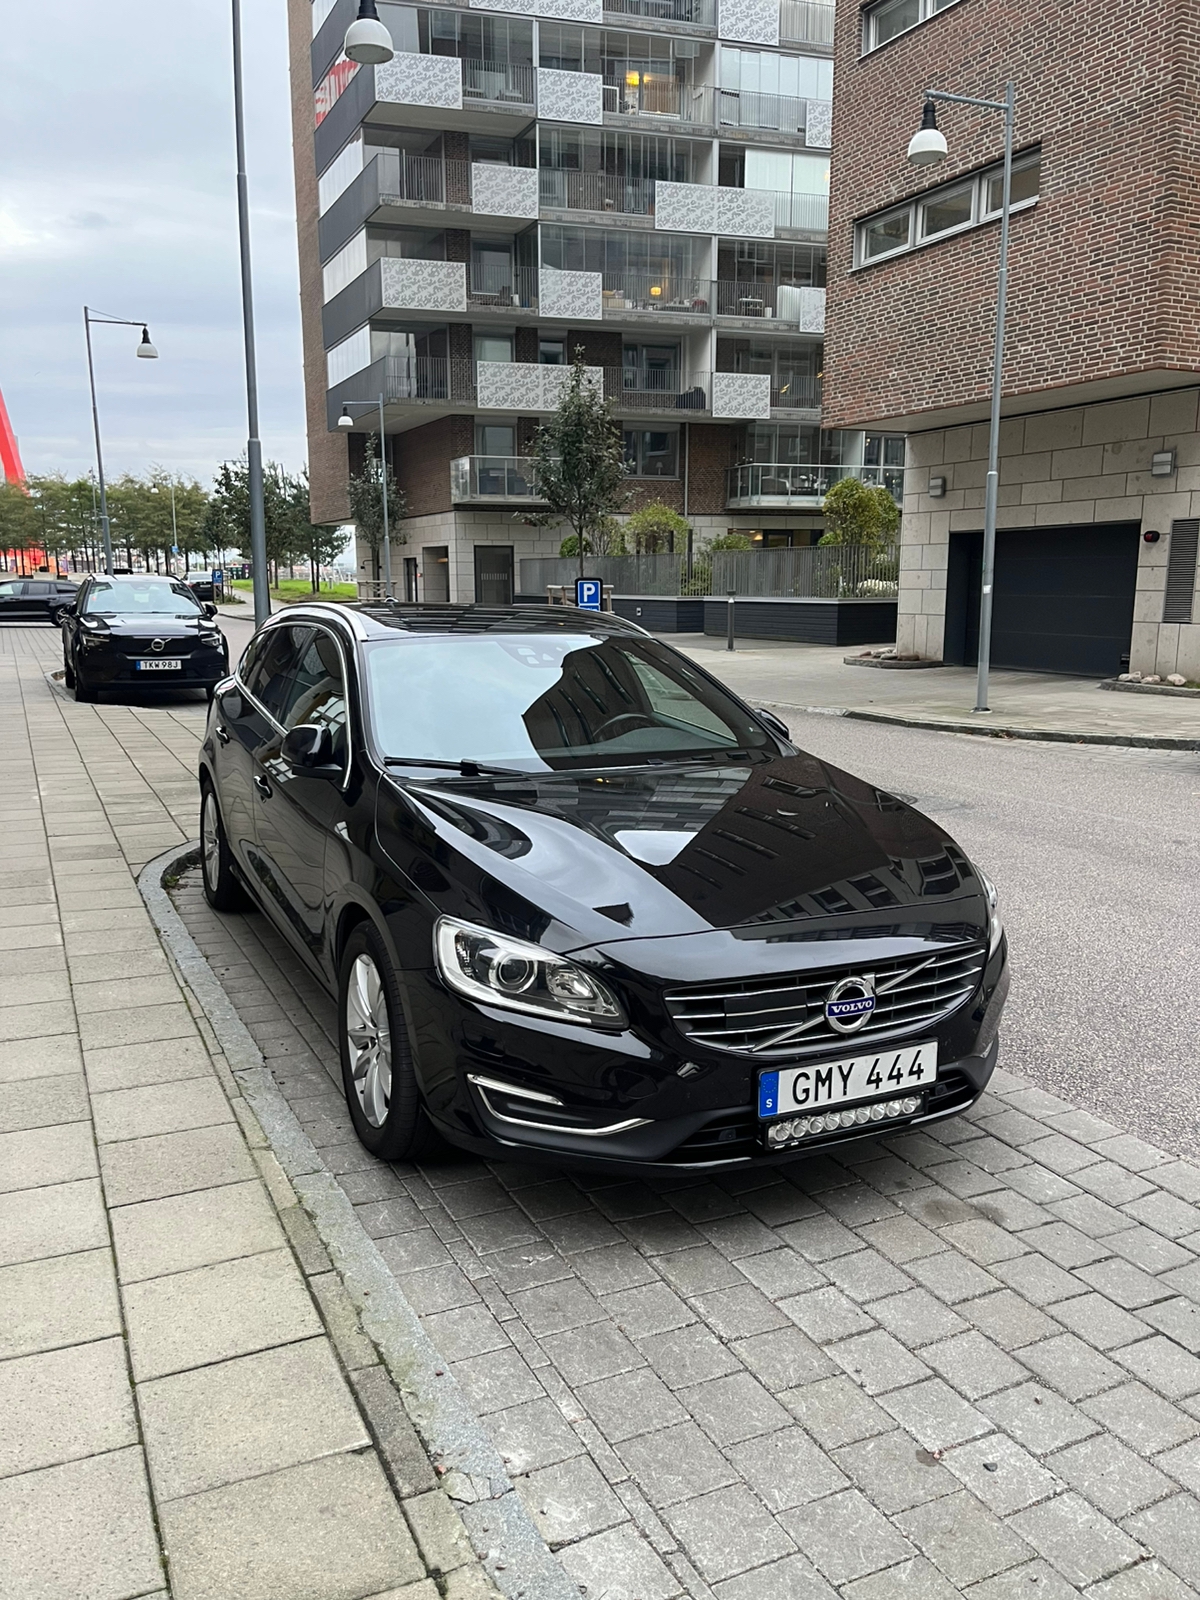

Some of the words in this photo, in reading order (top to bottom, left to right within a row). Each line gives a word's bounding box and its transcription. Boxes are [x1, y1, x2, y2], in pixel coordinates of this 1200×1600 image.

[583, 583, 596, 603] P
[143, 661, 160, 669] TKW
[161, 661, 178, 669] 98J
[831, 1000, 873, 1013] VOLVO
[792, 1062, 855, 1105] GMY
[866, 1049, 925, 1090] 444
[765, 1098, 773, 1108] S
